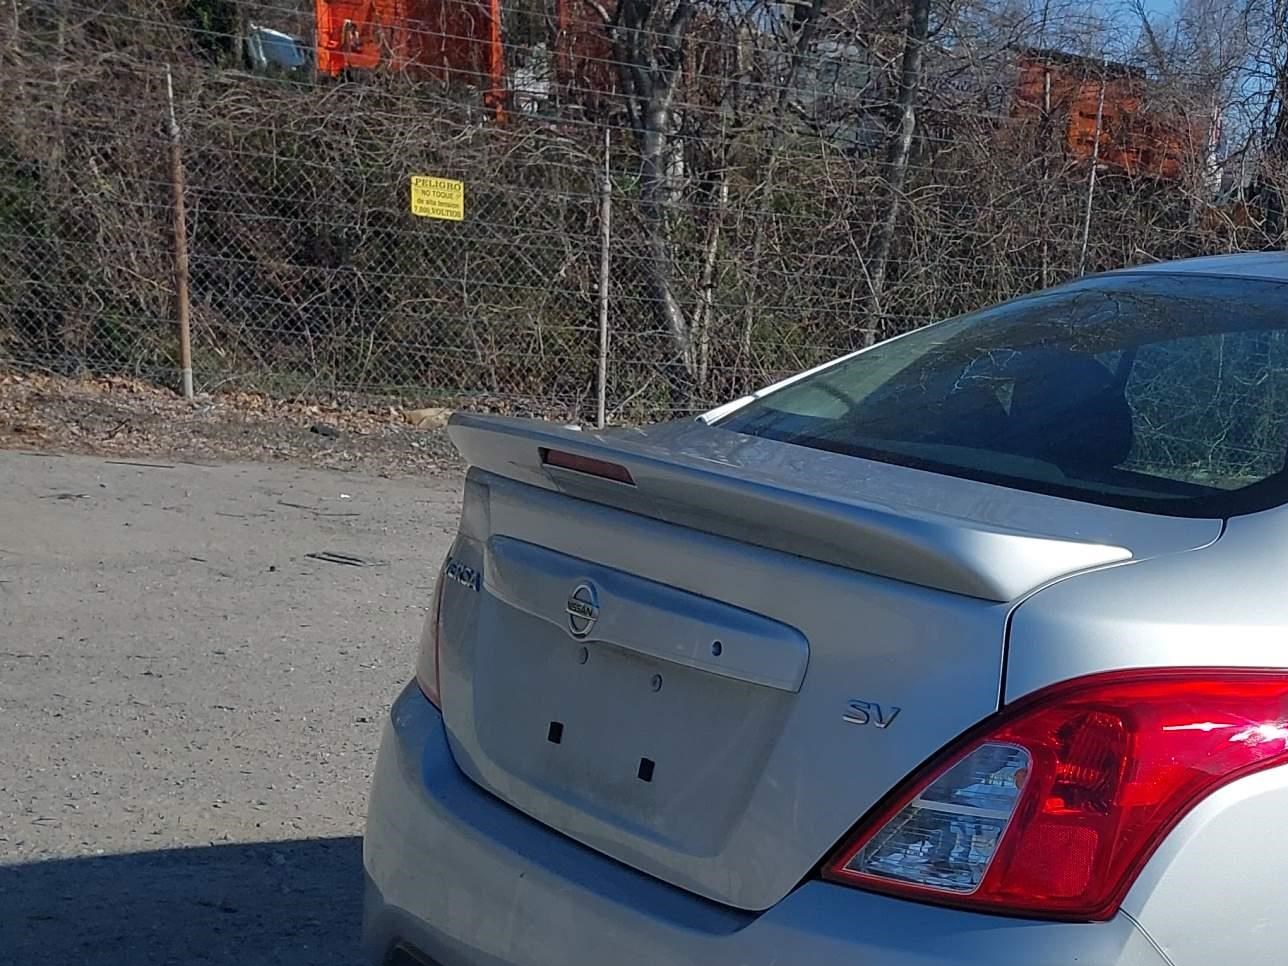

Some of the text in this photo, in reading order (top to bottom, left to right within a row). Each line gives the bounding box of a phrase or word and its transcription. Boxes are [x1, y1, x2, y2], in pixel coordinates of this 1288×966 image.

[415, 178, 461, 191] PELIGRO
[432, 190, 453, 200] TOQUE
[567, 600, 593, 617] NISSAN
[842, 699, 902, 728] SV
